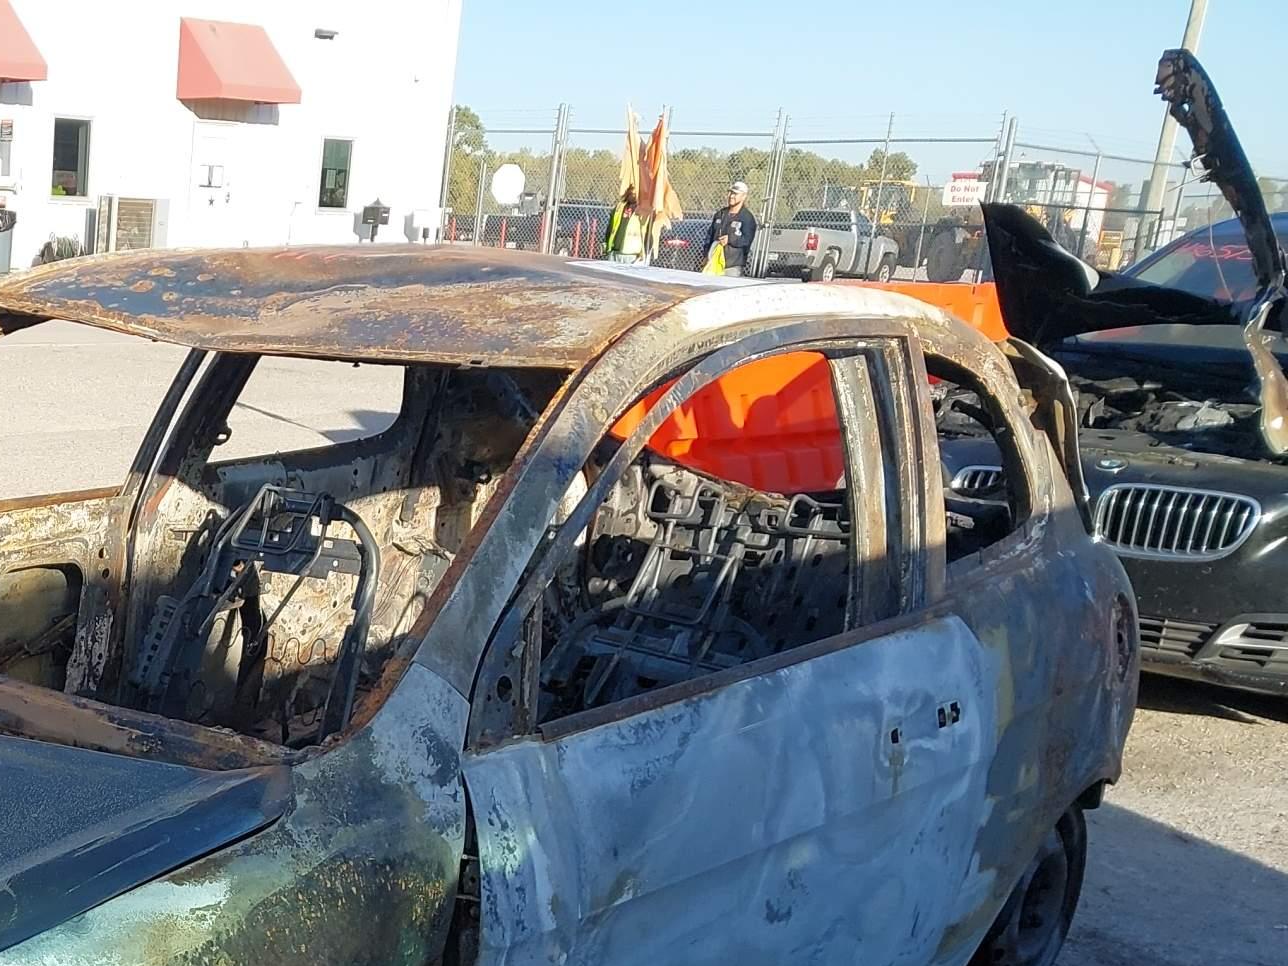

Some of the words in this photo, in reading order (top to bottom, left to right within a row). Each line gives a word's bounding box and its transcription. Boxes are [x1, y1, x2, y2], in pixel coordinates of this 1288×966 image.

[950, 185, 962, 193] Do
[964, 185, 979, 193] Not
[952, 195, 975, 203] Enter
